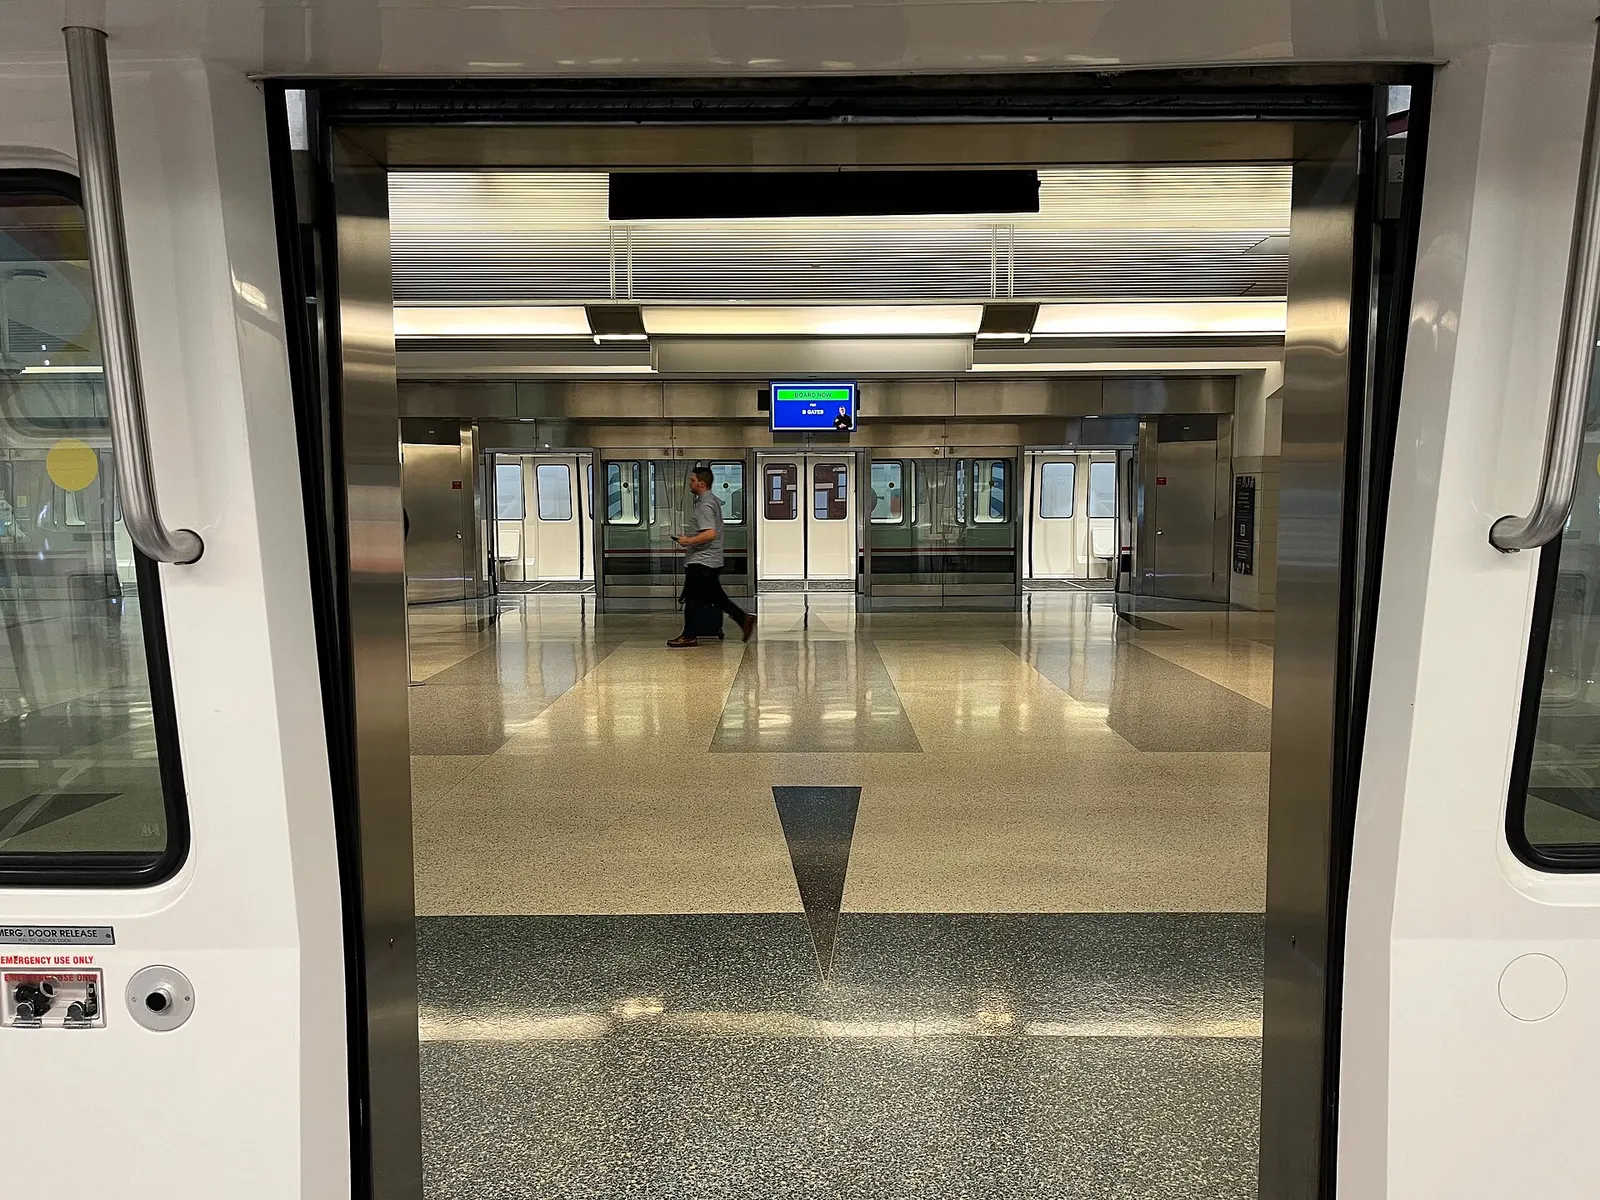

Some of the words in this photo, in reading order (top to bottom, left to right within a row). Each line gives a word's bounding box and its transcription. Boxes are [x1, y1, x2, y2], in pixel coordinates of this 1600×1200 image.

[1396, 171, 1403, 180] 2
[28, 929, 58, 937] DOOR
[60, 929, 98, 938] RELEASE
[0, 956, 51, 965] EMERGENCY
[54, 956, 70, 965] USE
[73, 956, 94, 965] ONLY
